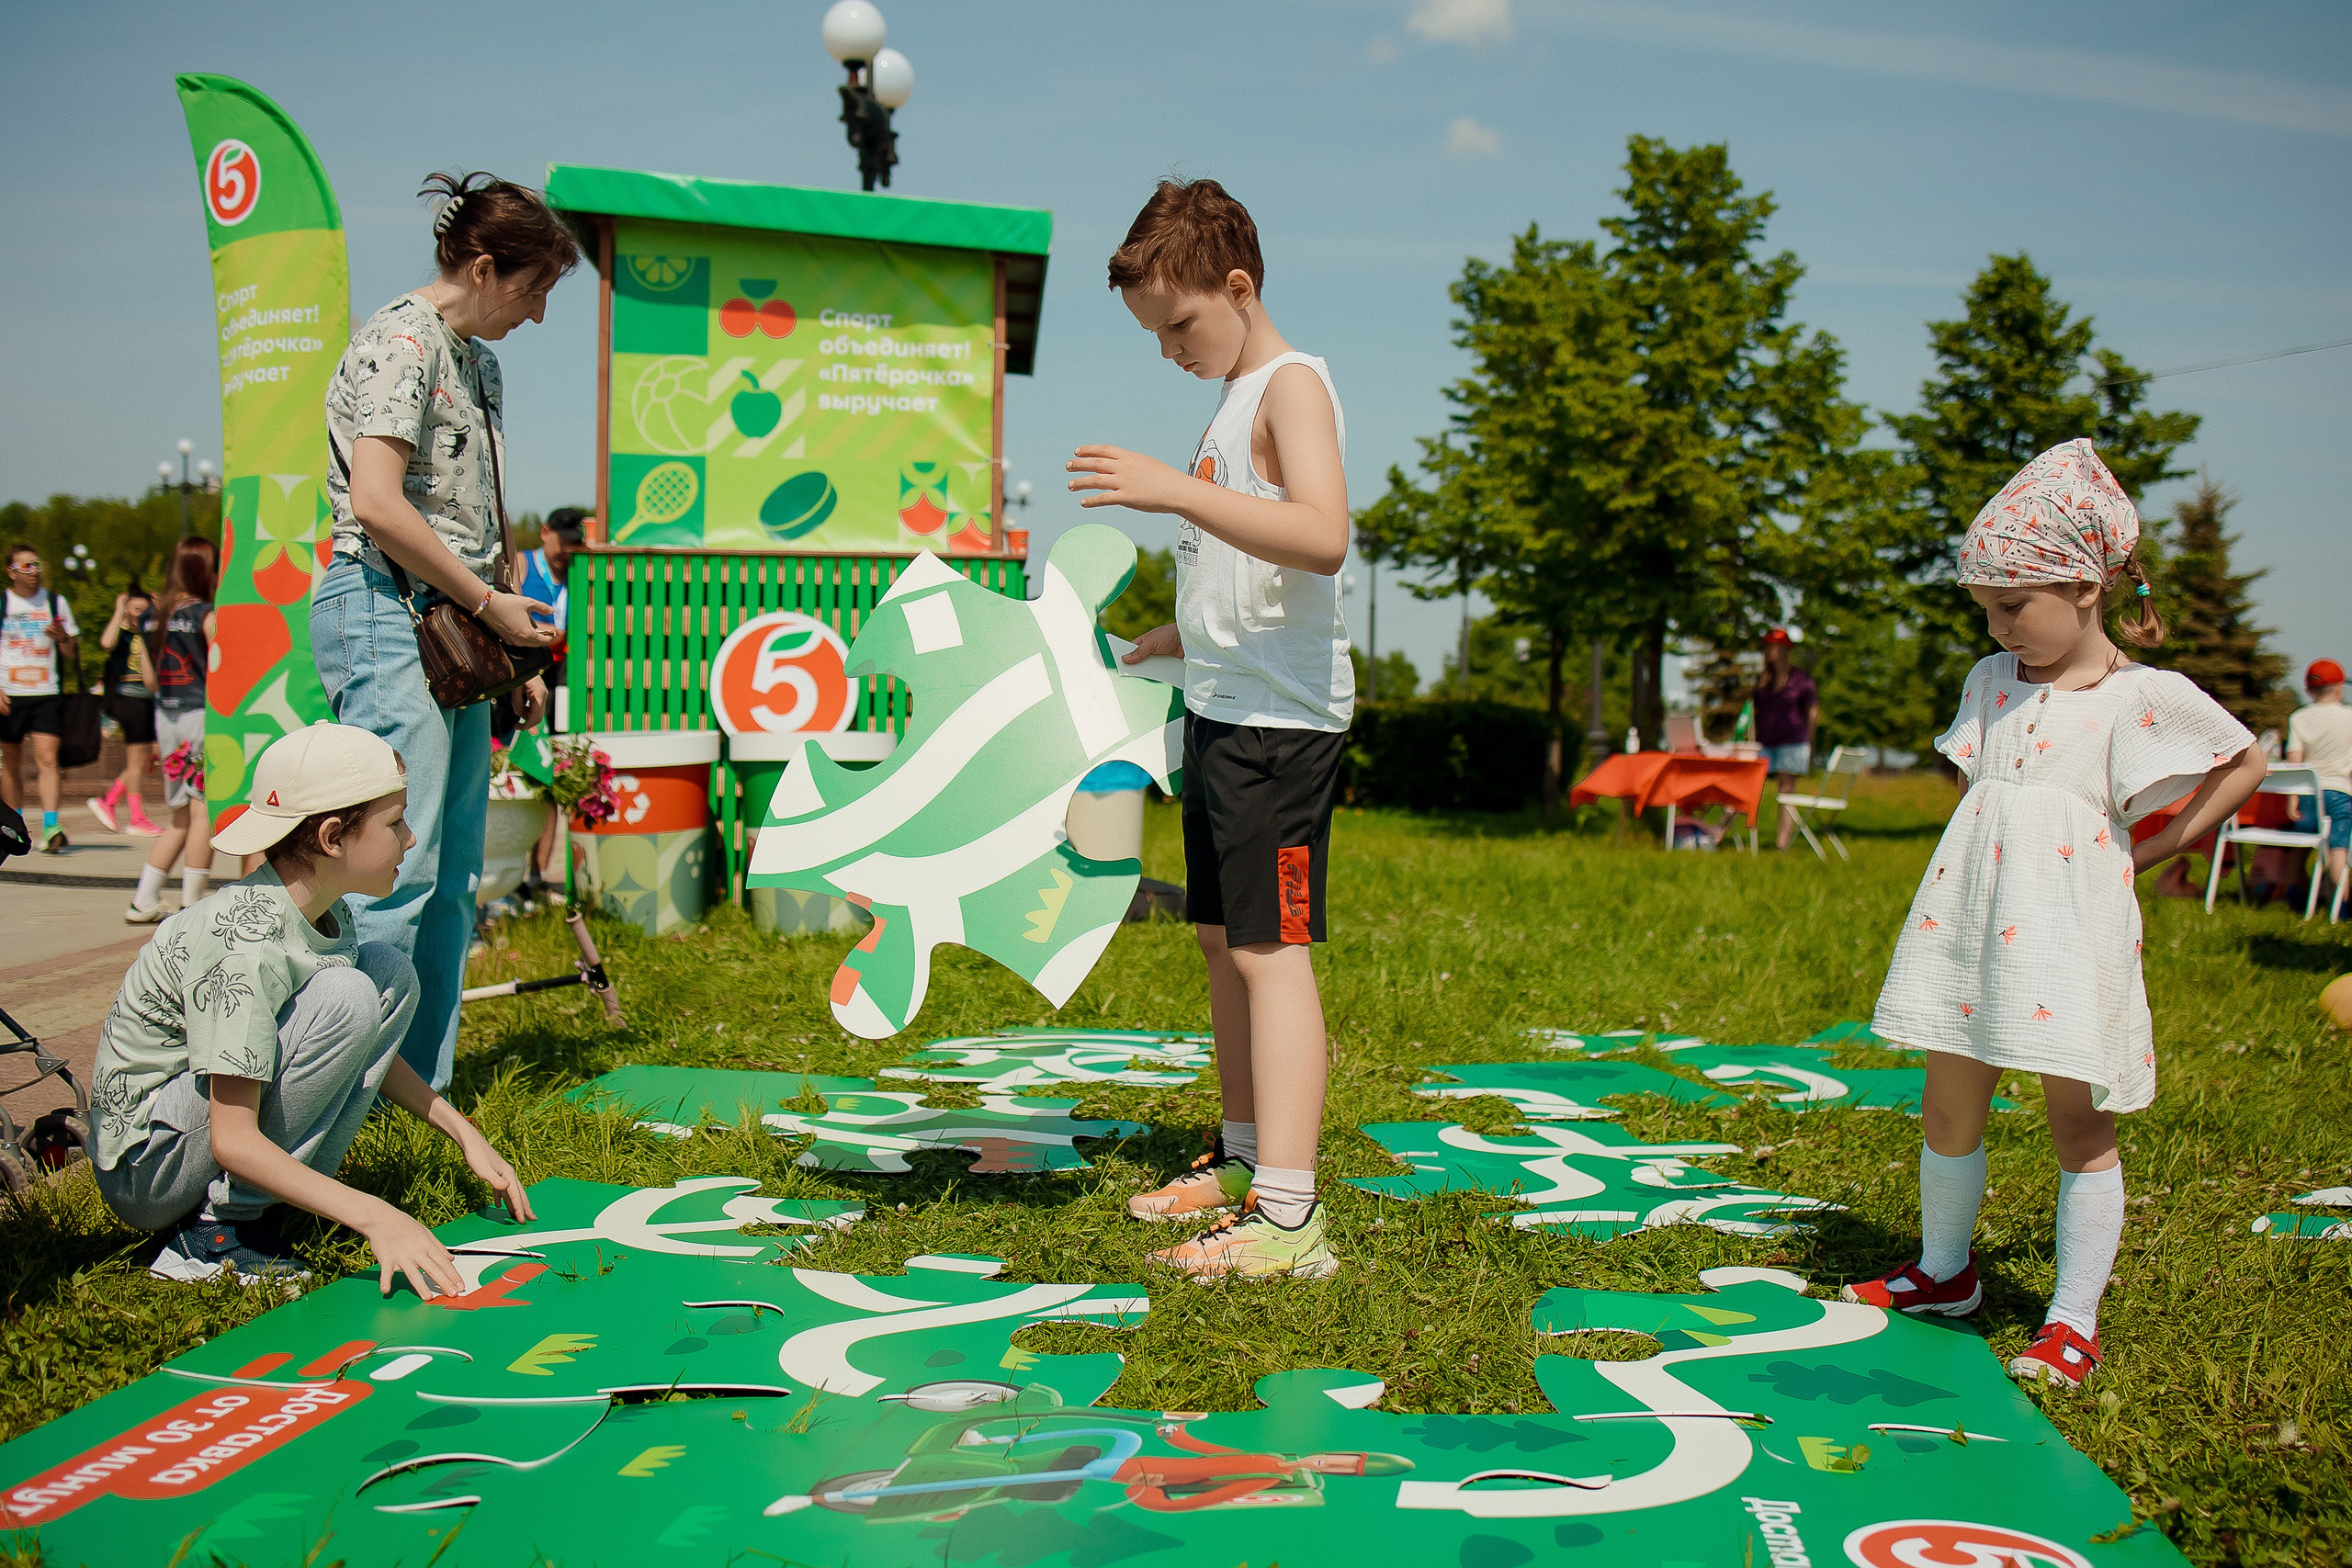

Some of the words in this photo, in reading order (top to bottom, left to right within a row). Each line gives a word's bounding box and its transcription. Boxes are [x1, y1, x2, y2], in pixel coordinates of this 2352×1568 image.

[217, 145, 246, 211] 5
[820, 308, 892, 333] Спорт
[819, 334, 971, 359] объединяет!
[819, 363, 975, 389] «Пятёрочка»
[819, 393, 939, 415] выручает
[750, 625, 822, 734] 5
[195, 1395, 250, 1418] от
[145, 1419, 215, 1443] 30
[150, 1388, 350, 1484] Доставка
[7, 1445, 157, 1517] минут
[1740, 1496, 1812, 1568] Доста
